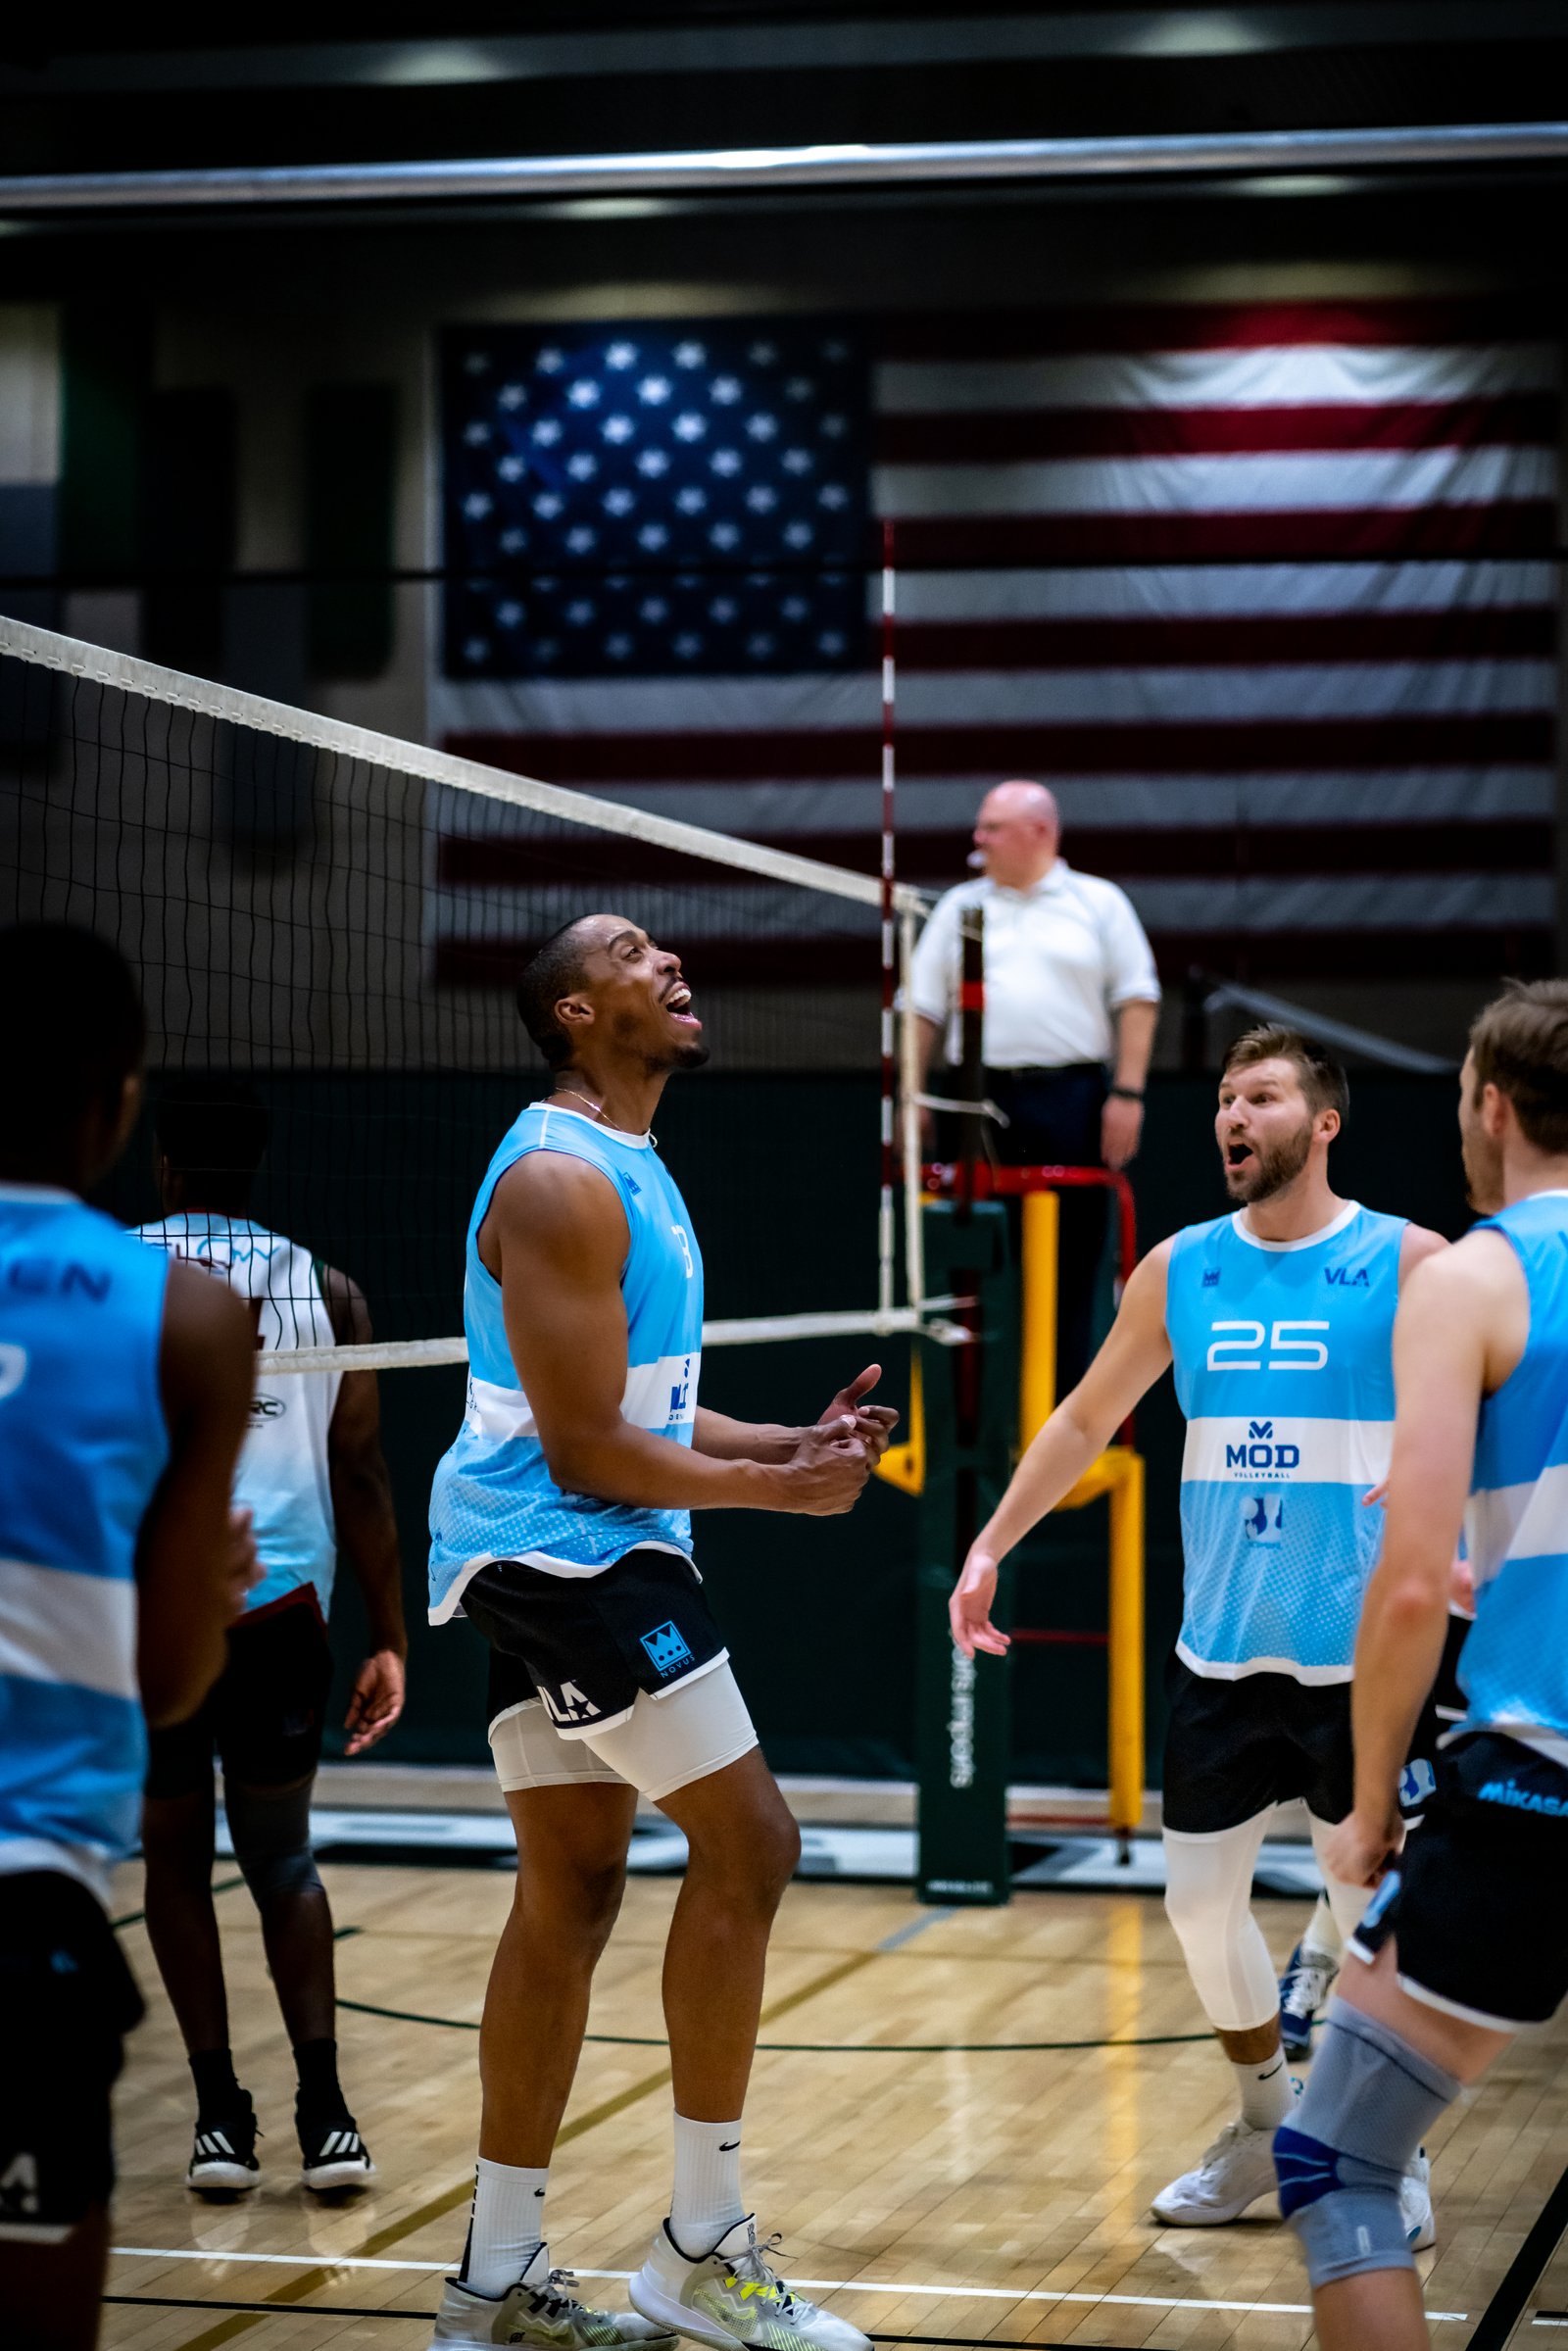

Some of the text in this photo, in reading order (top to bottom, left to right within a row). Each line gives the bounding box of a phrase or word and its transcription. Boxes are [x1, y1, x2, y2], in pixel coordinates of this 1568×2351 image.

[1323, 1267, 1370, 1287] VLA
[1206, 1320, 1330, 1372] 25
[1226, 1444, 1300, 1469] MOD
[660, 1653, 697, 1679] NOVUS
